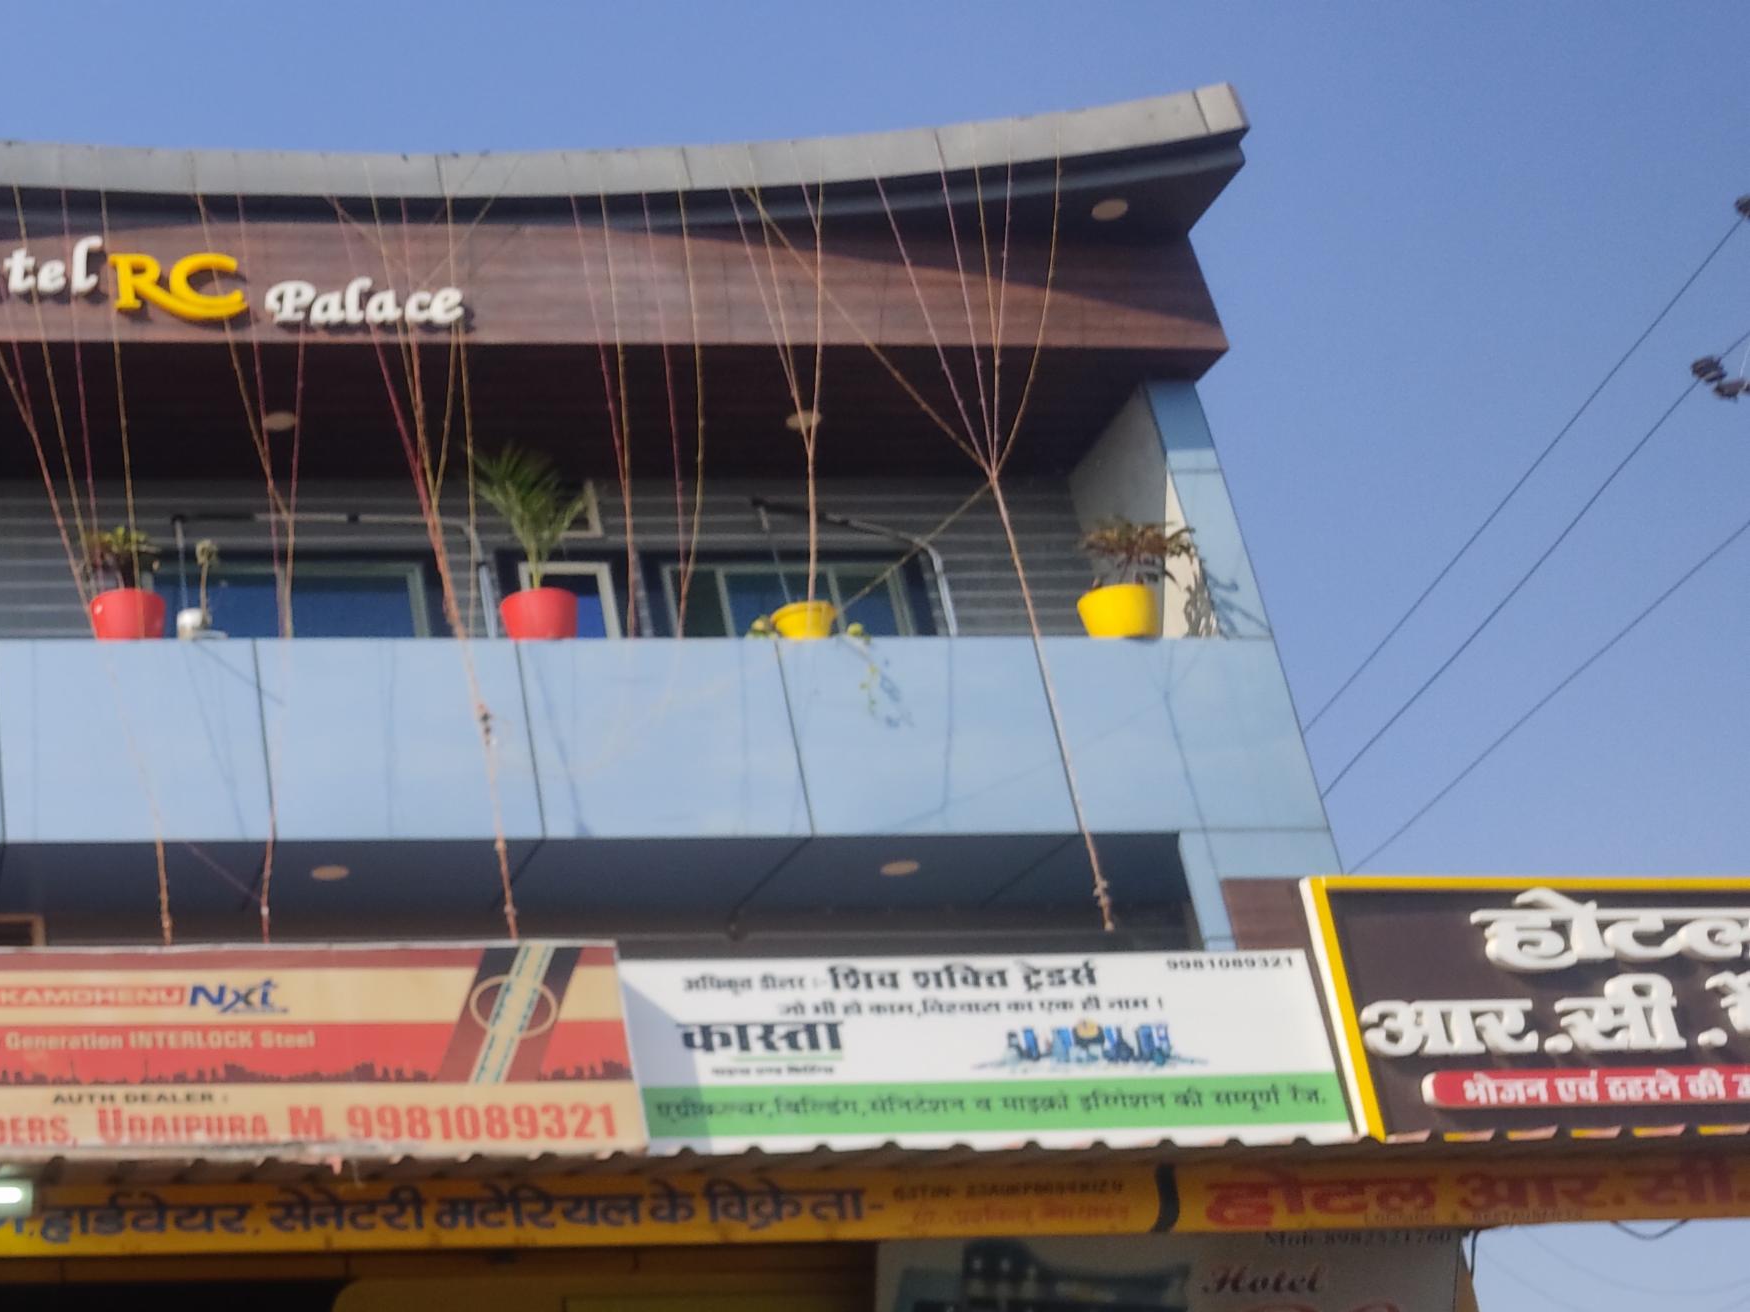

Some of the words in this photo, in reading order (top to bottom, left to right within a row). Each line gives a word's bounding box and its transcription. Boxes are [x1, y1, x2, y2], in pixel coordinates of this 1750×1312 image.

[108, 252, 249, 322] RC
[264, 277, 466, 326] Palace
[5, 1030, 124, 1051] Generation
[129, 1029, 254, 1050] INTERLOCK
[260, 1029, 316, 1048] Steel
[53, 1092, 113, 1105] AUTH
[123, 1091, 214, 1104] DEALER
[1463, 1073, 1548, 1105] भोजन
[1554, 1069, 1599, 1104] एवं
[1684, 1068, 1727, 1101] की
[345, 1102, 618, 1142] 9981089321
[650, 1178, 696, 1225] के
[1204, 1162, 1438, 1226] होटल
[1201, 1263, 1323, 1294] Hotel
